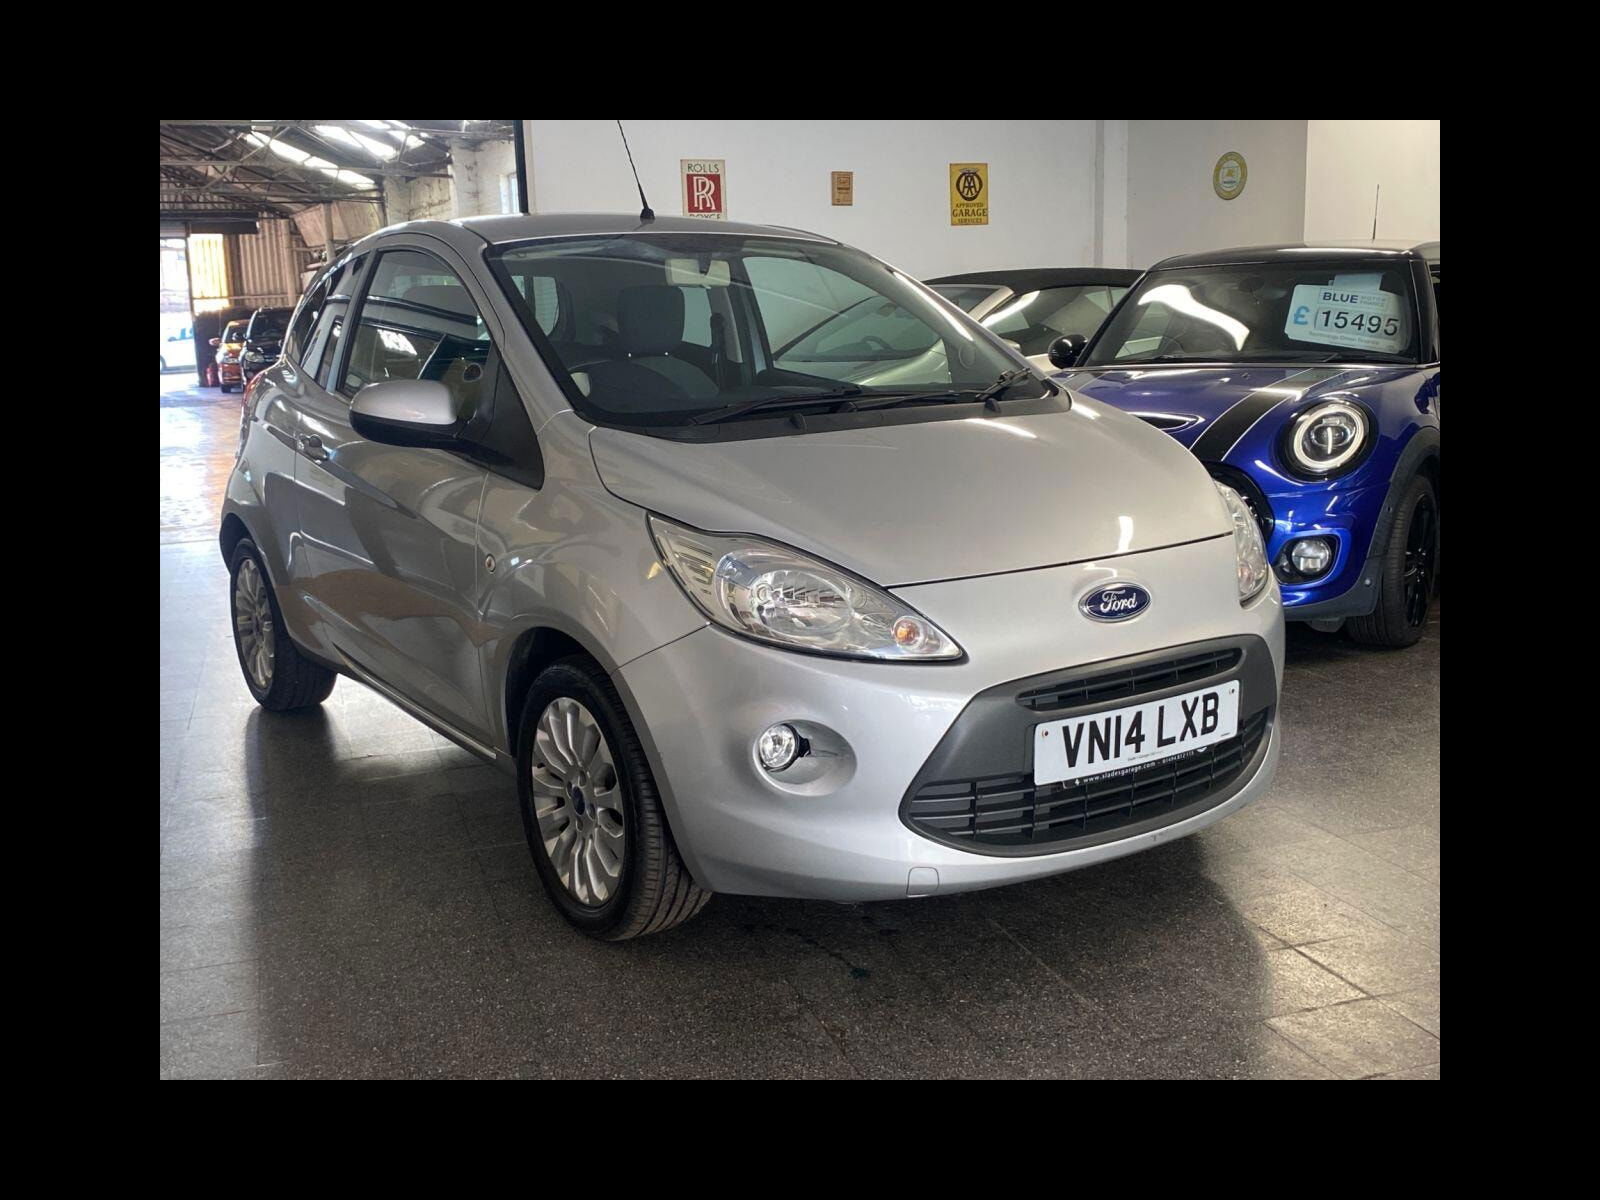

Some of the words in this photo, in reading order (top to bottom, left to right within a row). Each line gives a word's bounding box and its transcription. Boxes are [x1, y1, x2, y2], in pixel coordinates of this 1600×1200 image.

[687, 163, 719, 173] ROLLS
[952, 209, 987, 217] GARAGE
[1322, 292, 1359, 304] BLUE
[1293, 305, 1310, 326] £
[1322, 310, 1400, 336] 15495
[1100, 589, 1138, 613] Ford
[1062, 710, 1146, 768] VN14
[1157, 691, 1220, 748] LXB
[1083, 761, 1156, 783] www.sladesgarage.com
